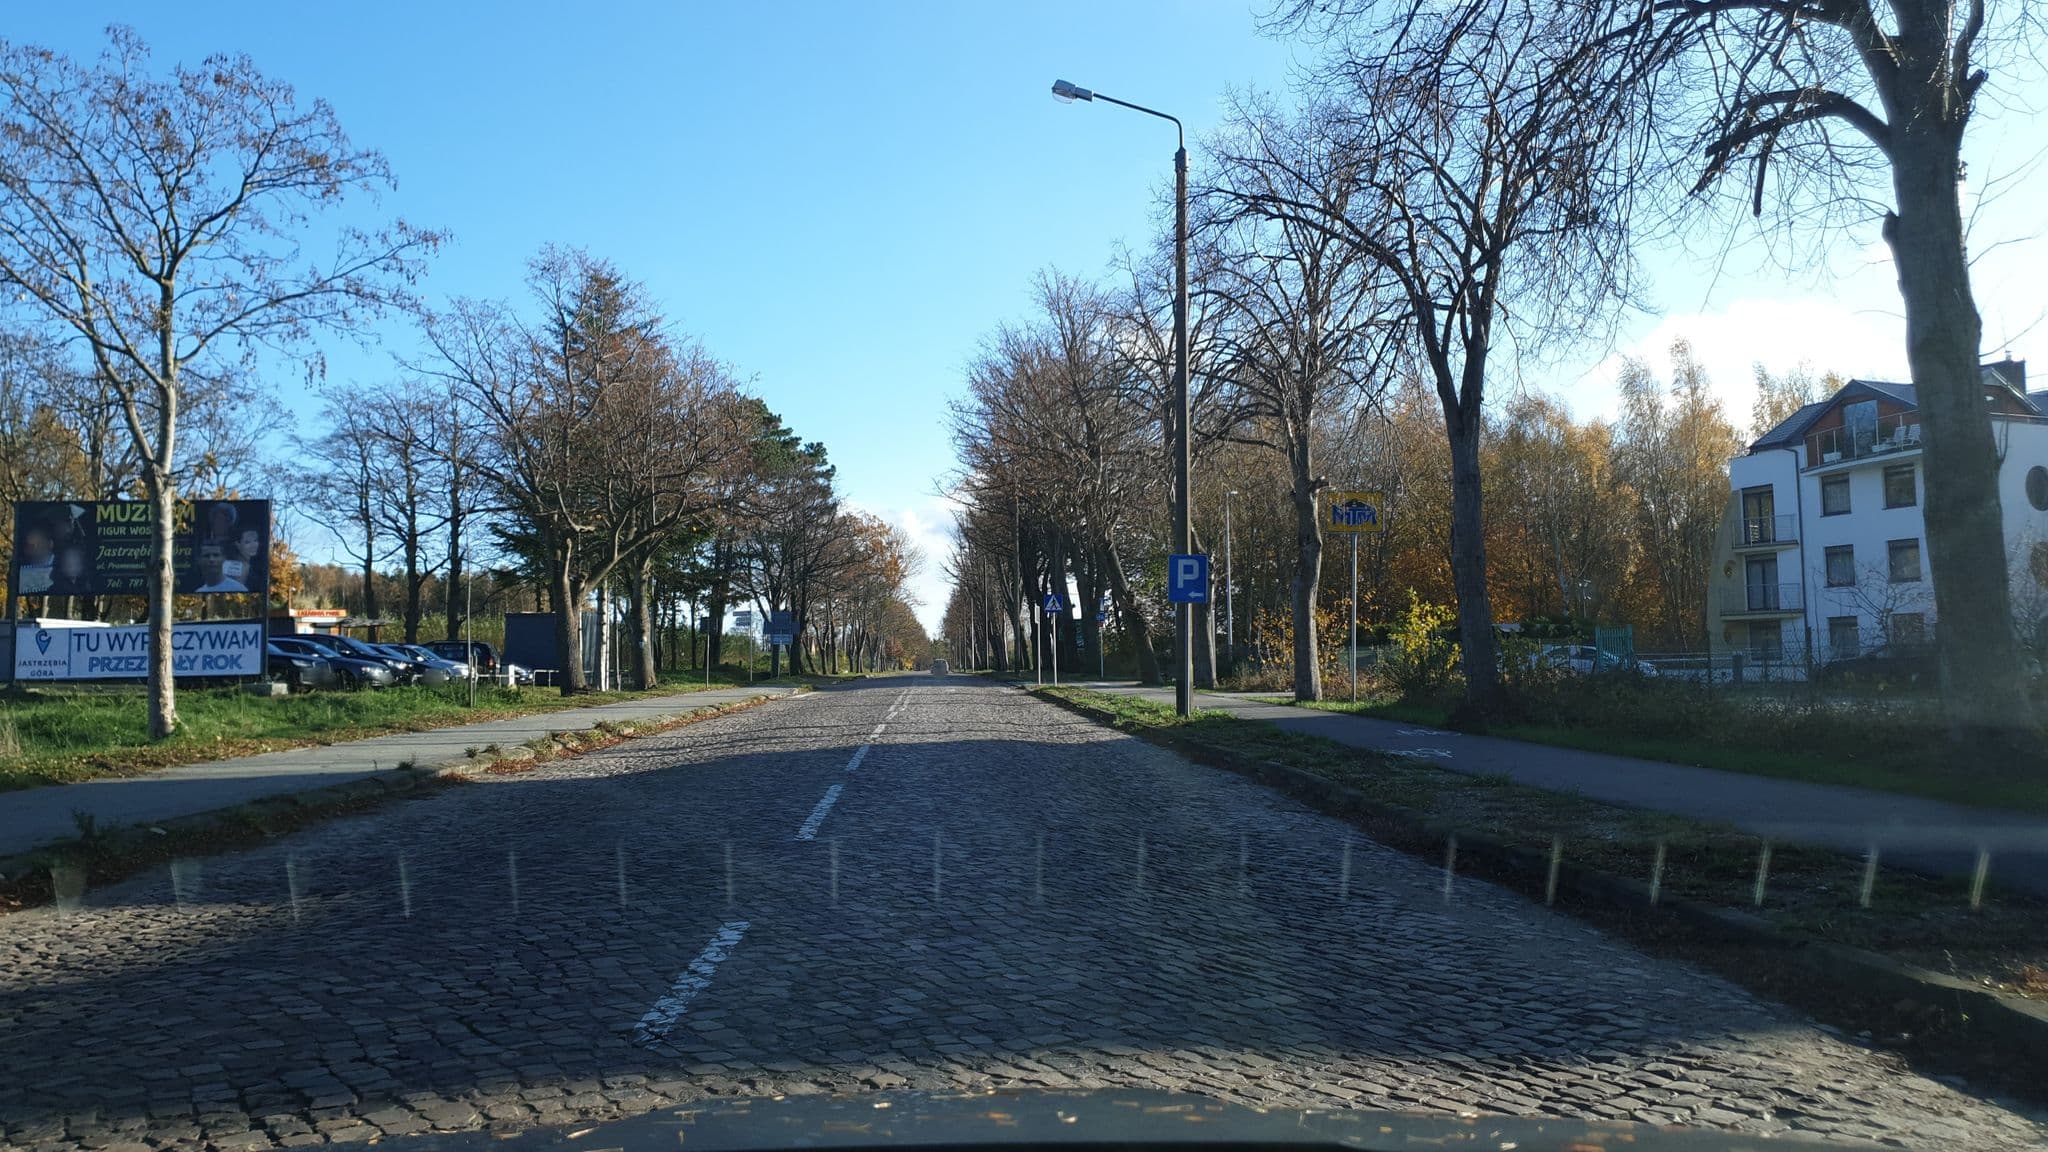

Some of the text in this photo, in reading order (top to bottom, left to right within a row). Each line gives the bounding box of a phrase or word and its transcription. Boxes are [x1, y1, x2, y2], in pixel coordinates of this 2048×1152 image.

[97, 526, 126, 536] FIGUR
[96, 544, 151, 560] Jastrzębi
[1177, 559, 1199, 589] P
[73, 630, 259, 652] TU WYPCZYWAM
[88, 656, 148, 673] PRZEZ
[202, 653, 243, 670] ROK
[30, 669, 54, 677] GÓRA
